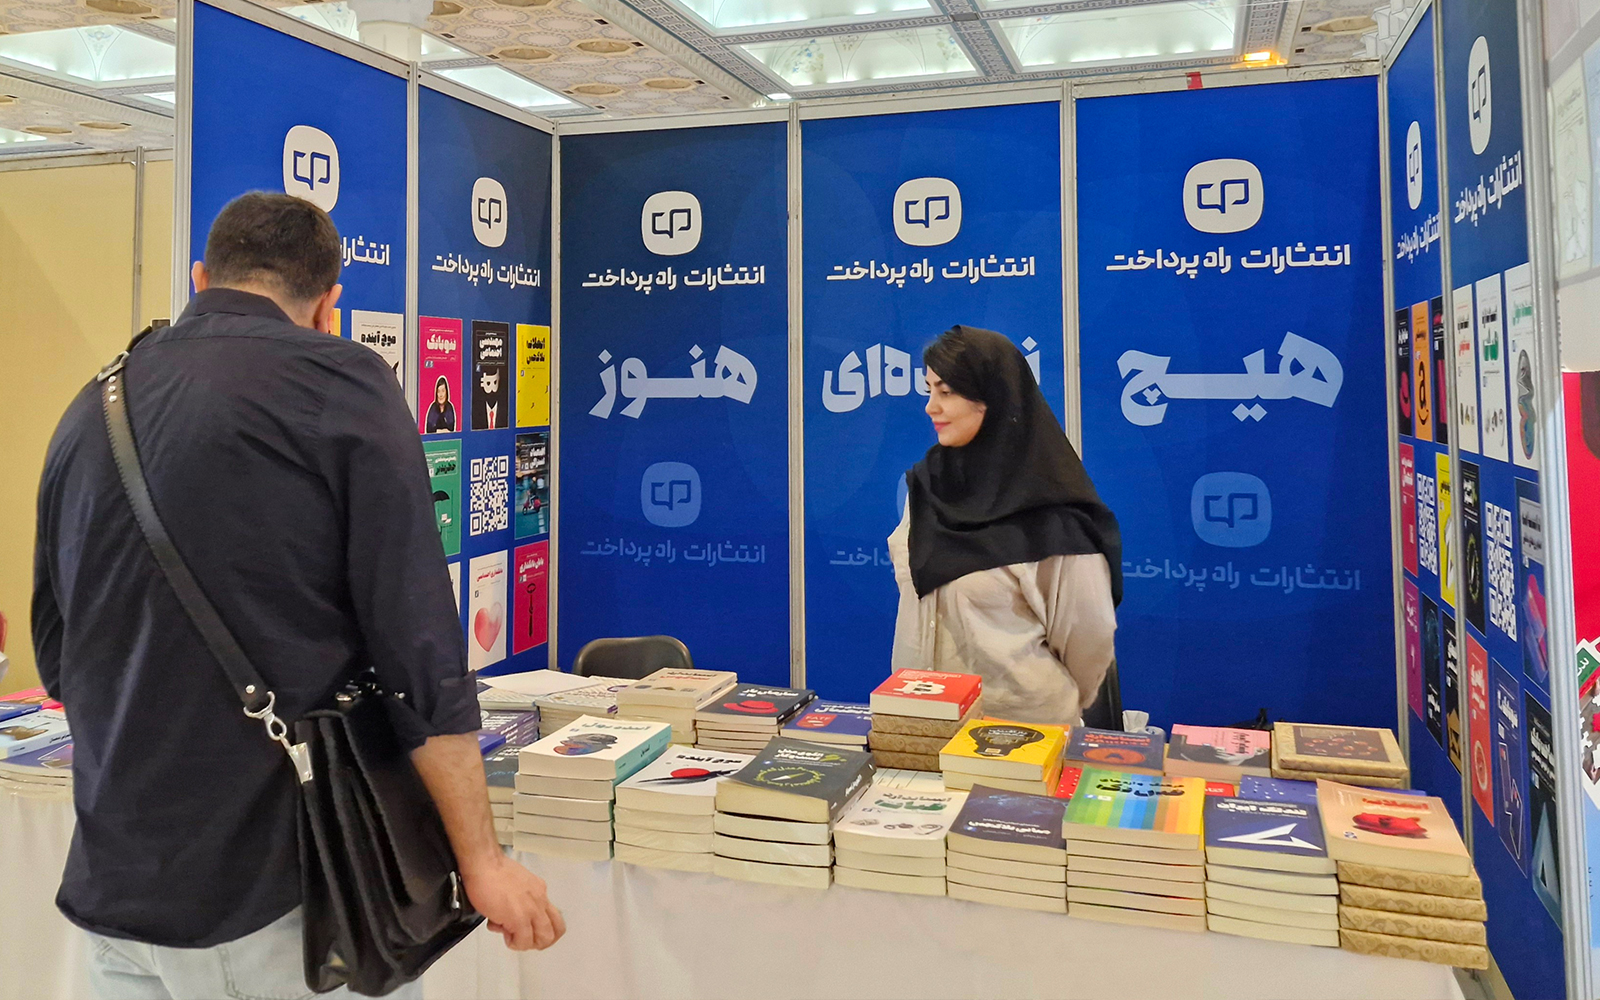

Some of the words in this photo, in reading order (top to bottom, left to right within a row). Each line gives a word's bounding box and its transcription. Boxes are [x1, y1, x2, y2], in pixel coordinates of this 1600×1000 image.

[1488, 150, 1523, 210] انتشارات
[340, 235, 391, 267] انتشارا
[1106, 249, 1200, 279] پرداخت
[1203, 246, 1231, 274] راه
[1241, 242, 1351, 275] انتشارات
[431, 253, 480, 286] پرداخت
[480, 258, 493, 285] راه
[497, 263, 541, 289] انتشارات
[581, 266, 653, 295] پرداخت
[655, 266, 677, 291] راه
[684, 263, 765, 291] انتشارات
[826, 258, 907, 288] پرداخت
[909, 258, 934, 283] راه
[941, 254, 1036, 284] انتشارات
[588, 344, 758, 420] هنوز
[1116, 331, 1344, 427] هیچ
[580, 537, 653, 567] پرداخت
[655, 539, 677, 564] راه
[684, 540, 766, 567] انتشارات
[1212, 561, 1239, 589] راه
[1250, 563, 1360, 594] انتشارات
